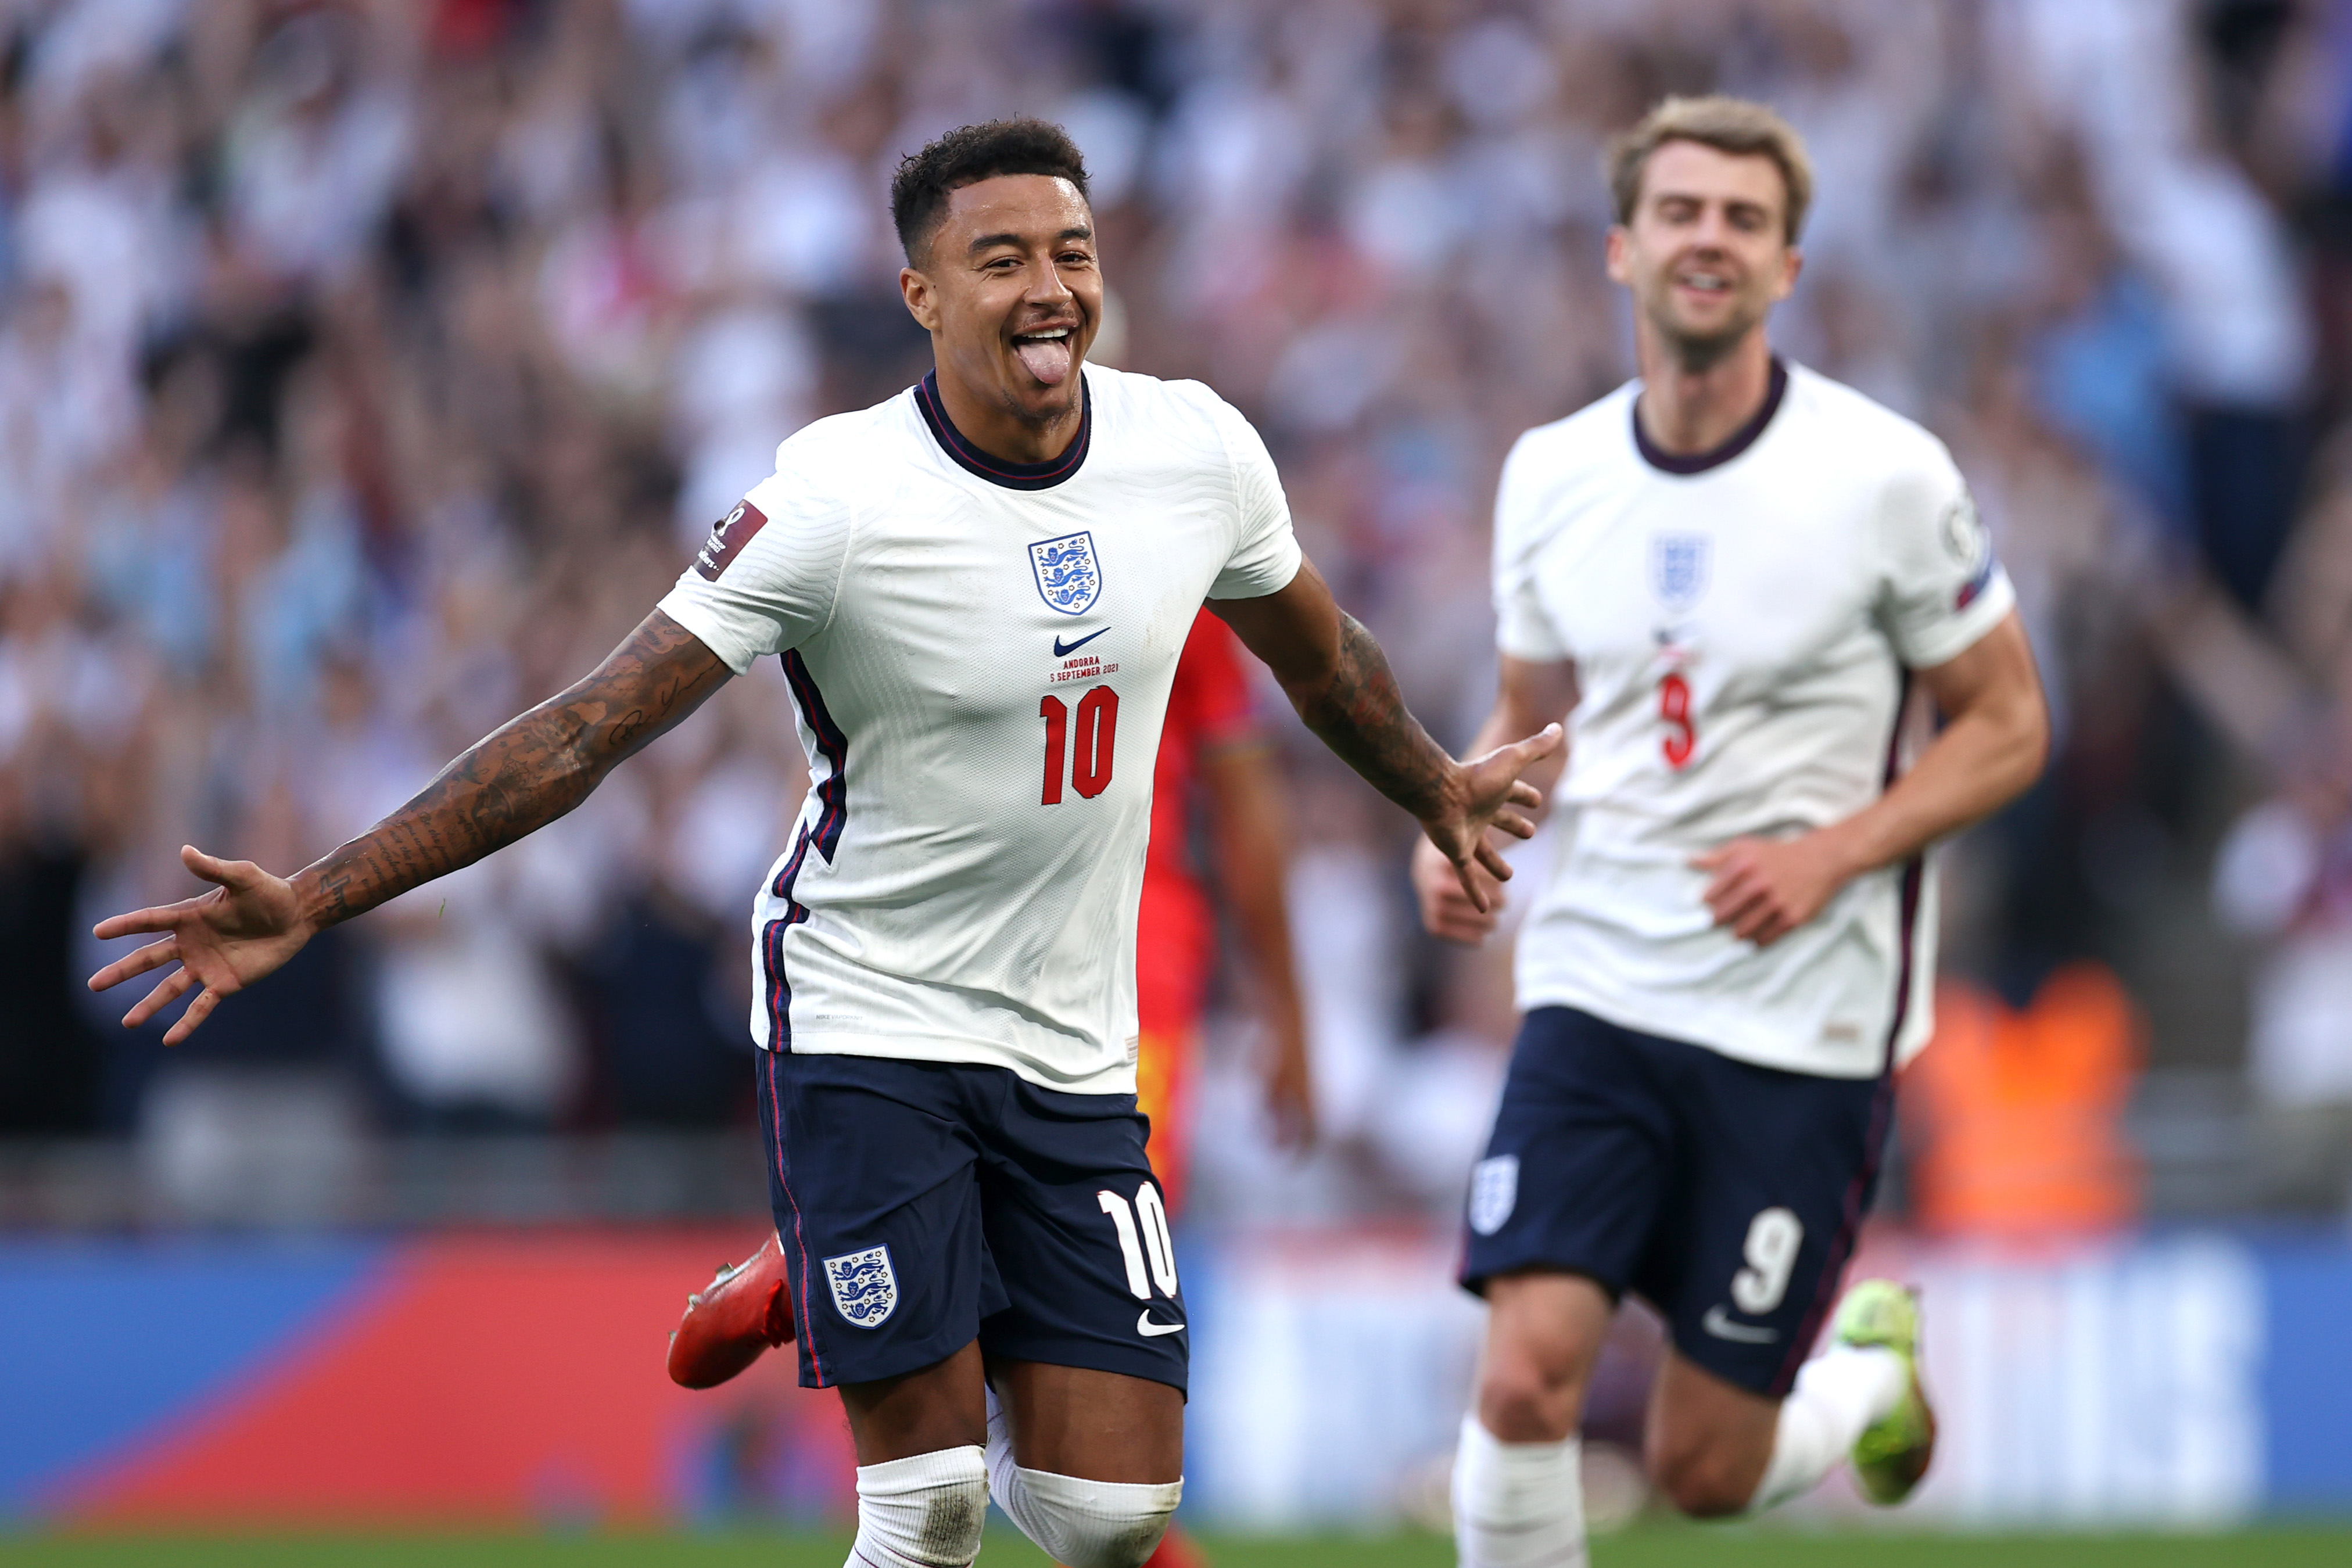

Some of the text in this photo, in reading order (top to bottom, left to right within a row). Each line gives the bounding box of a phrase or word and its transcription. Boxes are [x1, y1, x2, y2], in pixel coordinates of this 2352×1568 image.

[1050, 663, 1118, 682] 5 SEPTEMBER 2021
[1063, 656, 1100, 670] ANDORRA
[1040, 684, 1119, 805] 10
[1659, 670, 1695, 772] 9
[1096, 1181, 1177, 1300] 10
[1730, 1206, 1805, 1315] 9
